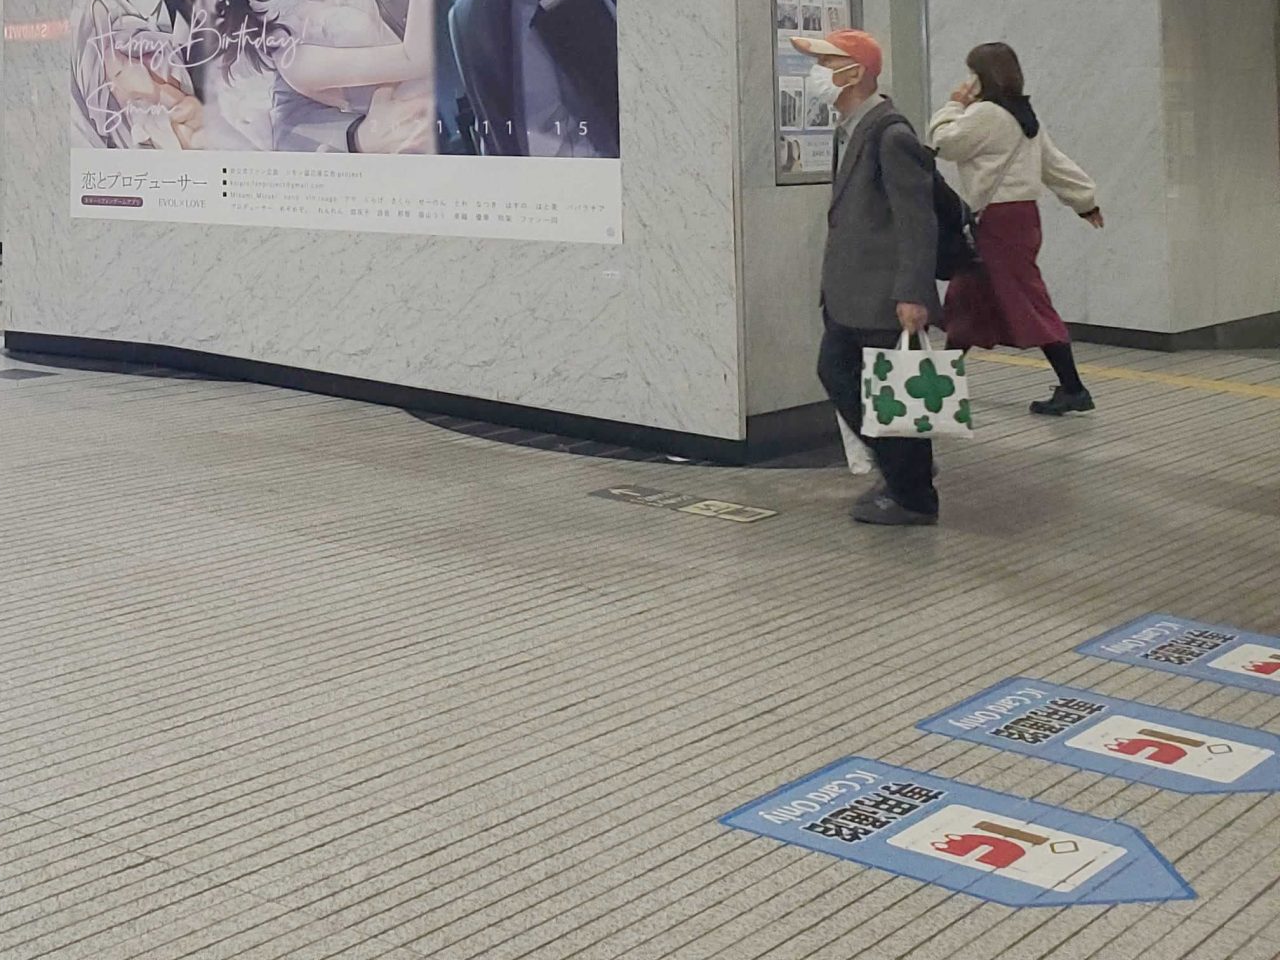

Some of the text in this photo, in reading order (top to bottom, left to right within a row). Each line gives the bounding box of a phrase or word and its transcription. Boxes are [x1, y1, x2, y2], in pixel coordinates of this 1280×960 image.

[87, 13, 172, 71] Happy
[81, 170, 208, 191] 恋とプロデューサー
[758, 770, 883, 825] IC Card Only
